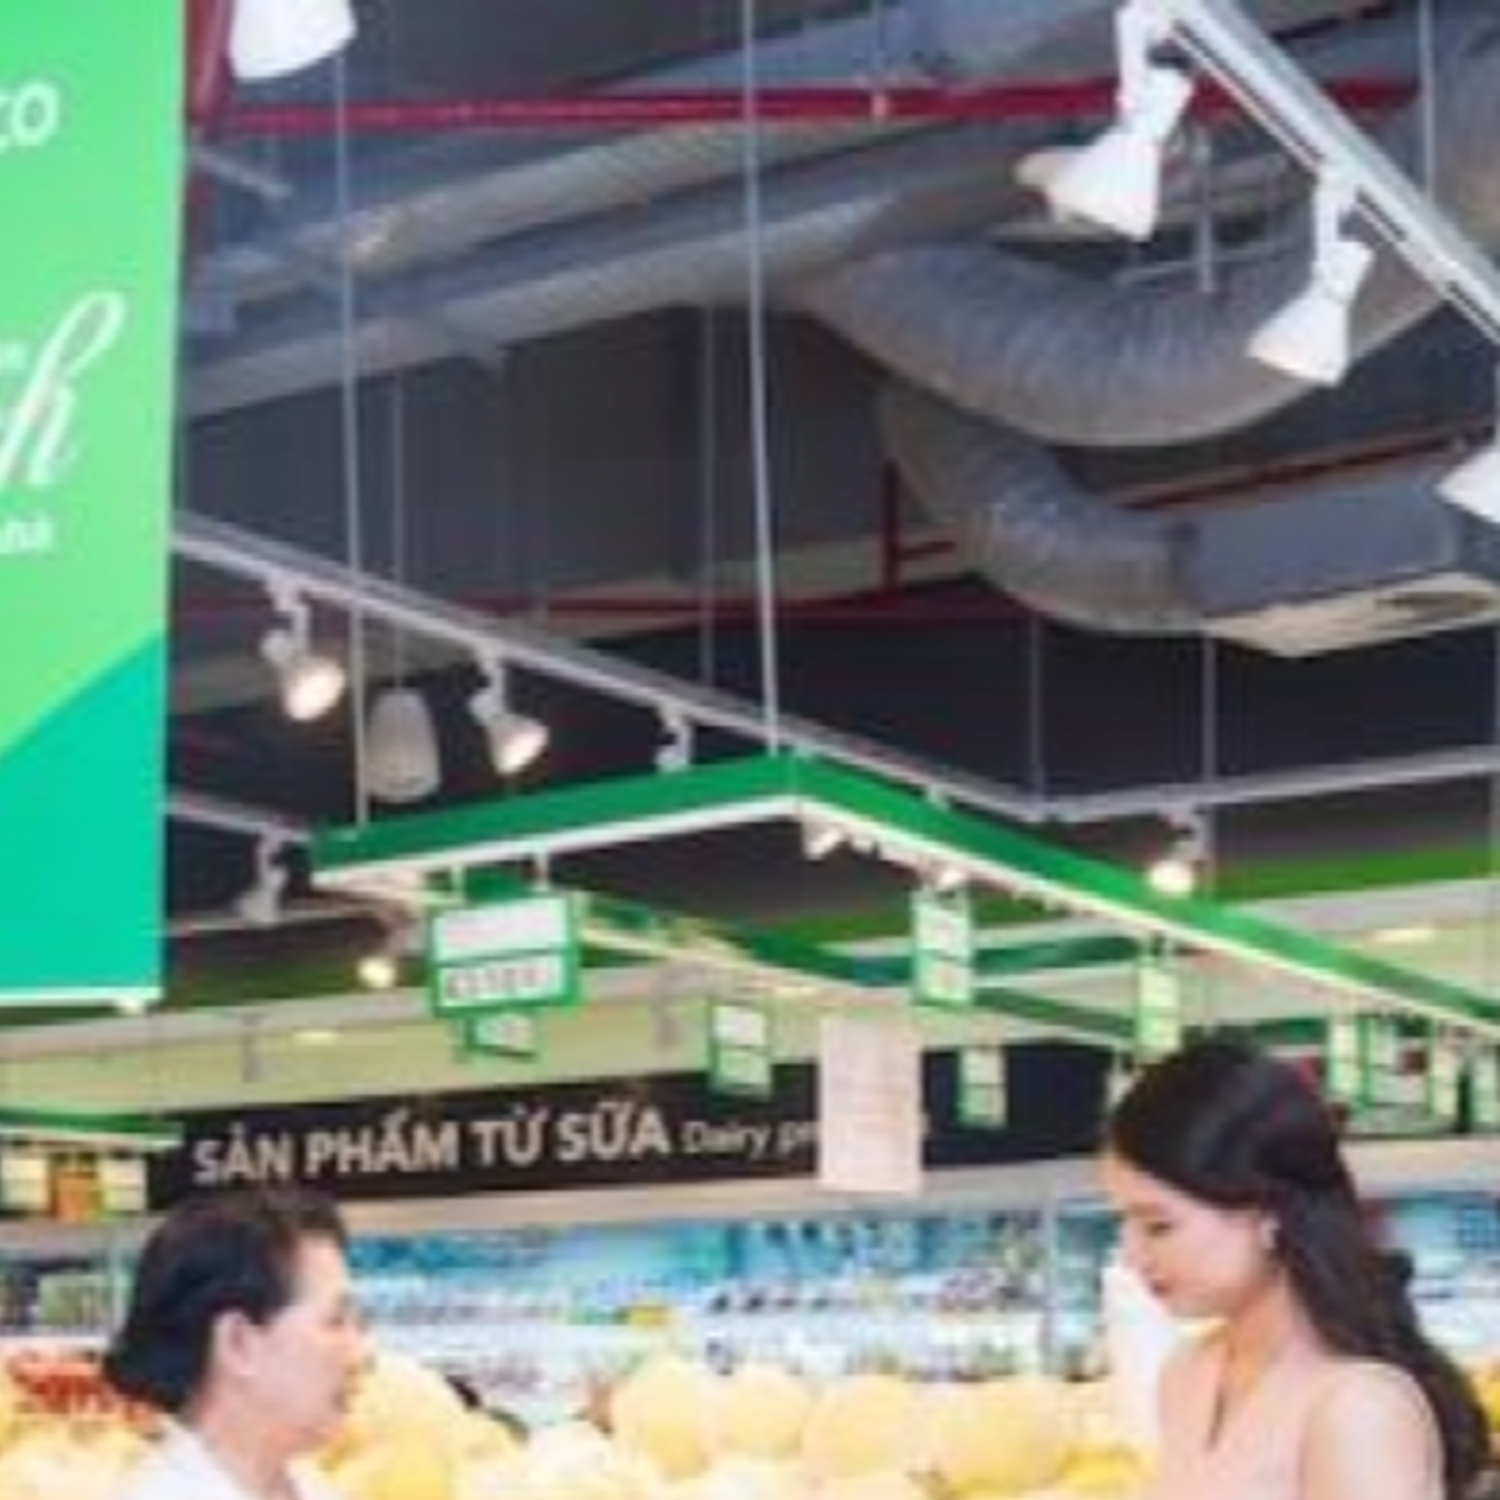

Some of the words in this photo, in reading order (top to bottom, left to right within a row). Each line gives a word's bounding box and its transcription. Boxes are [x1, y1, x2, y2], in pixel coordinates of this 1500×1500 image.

[193, 1121, 297, 1187] SẢN
[471, 1102, 550, 1167] TỪ
[557, 1100, 673, 1162] SỮA
[682, 1117, 768, 1161] Dairy
